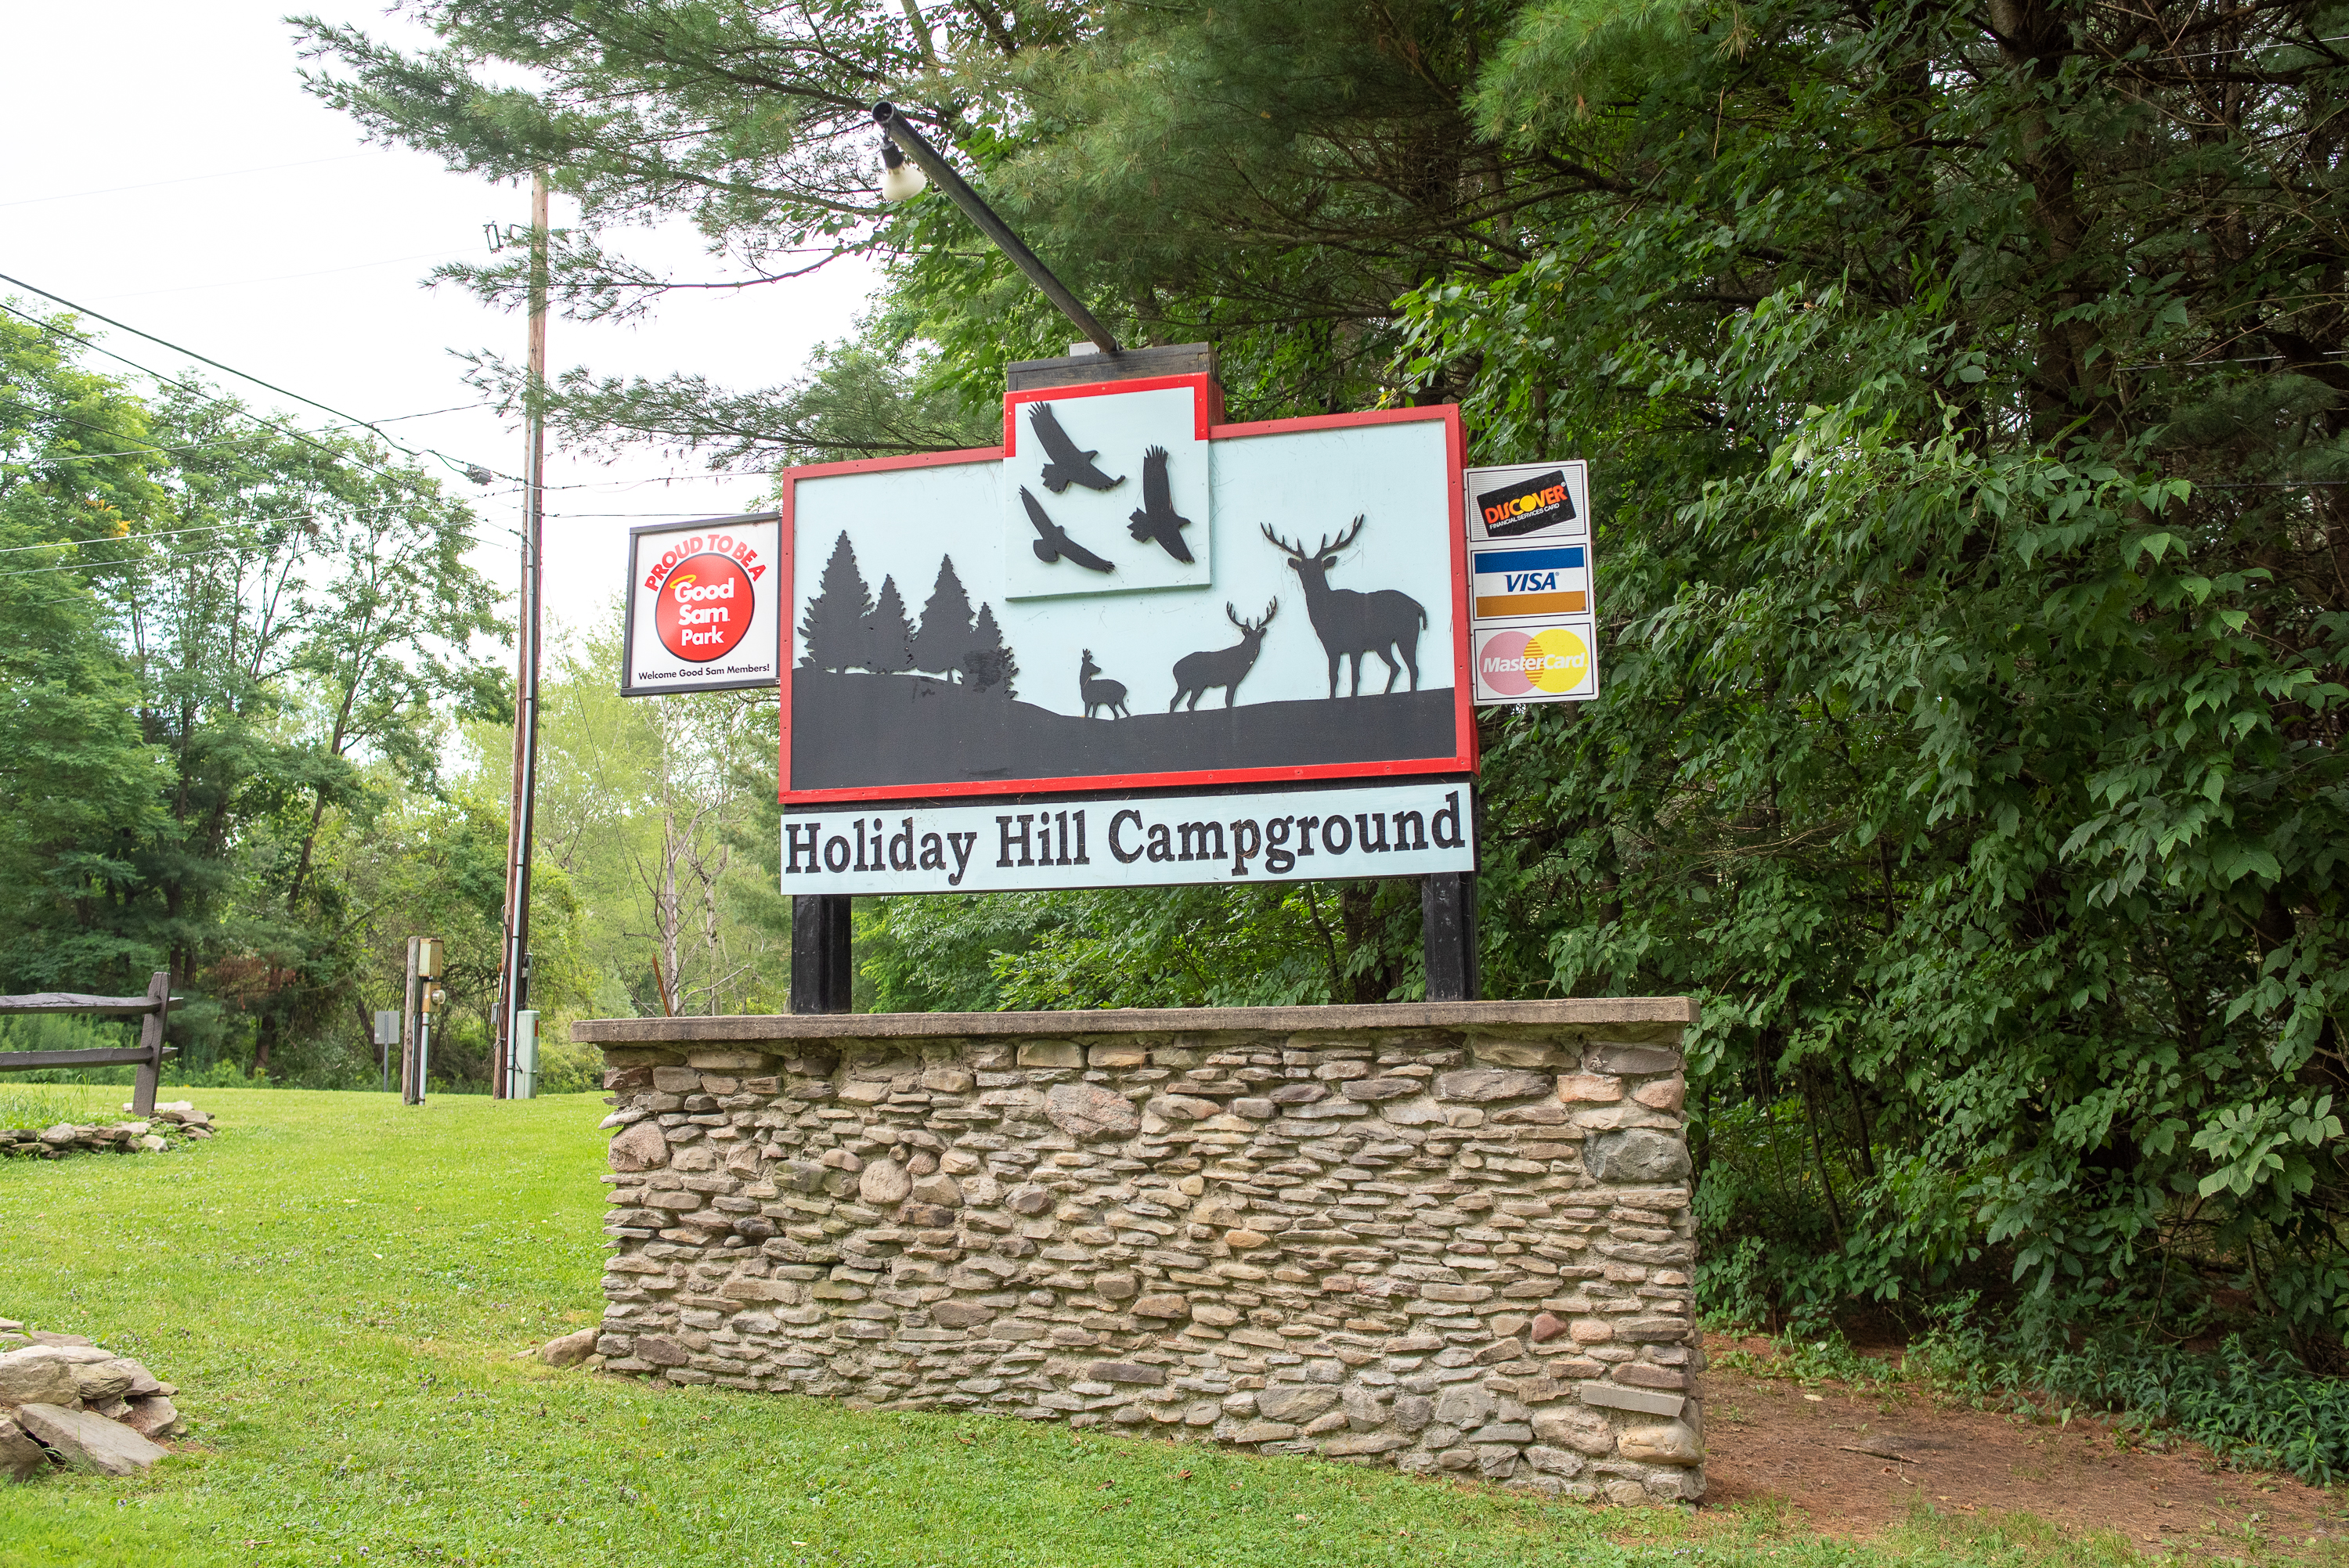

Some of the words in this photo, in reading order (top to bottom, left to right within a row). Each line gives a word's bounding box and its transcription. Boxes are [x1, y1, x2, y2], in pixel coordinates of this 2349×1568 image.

[1485, 485, 1568, 524] DISCOVER
[1489, 517, 1517, 530] FINANCIAL
[1517, 508, 1544, 521] SERVICES
[1544, 503, 1560, 512] CARD
[644, 536, 703, 592] PROUD
[707, 534, 733, 553] TO
[732, 542, 758, 568] BE
[748, 564, 767, 582] A
[674, 578, 734, 603] Good
[1504, 572, 1557, 592] VISA
[678, 604, 729, 625] Sam
[681, 625, 724, 646] Park
[639, 671, 677, 680] Welcome
[679, 668, 703, 677] Good
[705, 667, 724, 676] Sam
[727, 664, 770, 674] Members!
[1483, 652, 1586, 673] MasterCard
[785, 816, 977, 885] Holiday
[996, 809, 1090, 867] Hill
[1108, 791, 1465, 877] Campground
